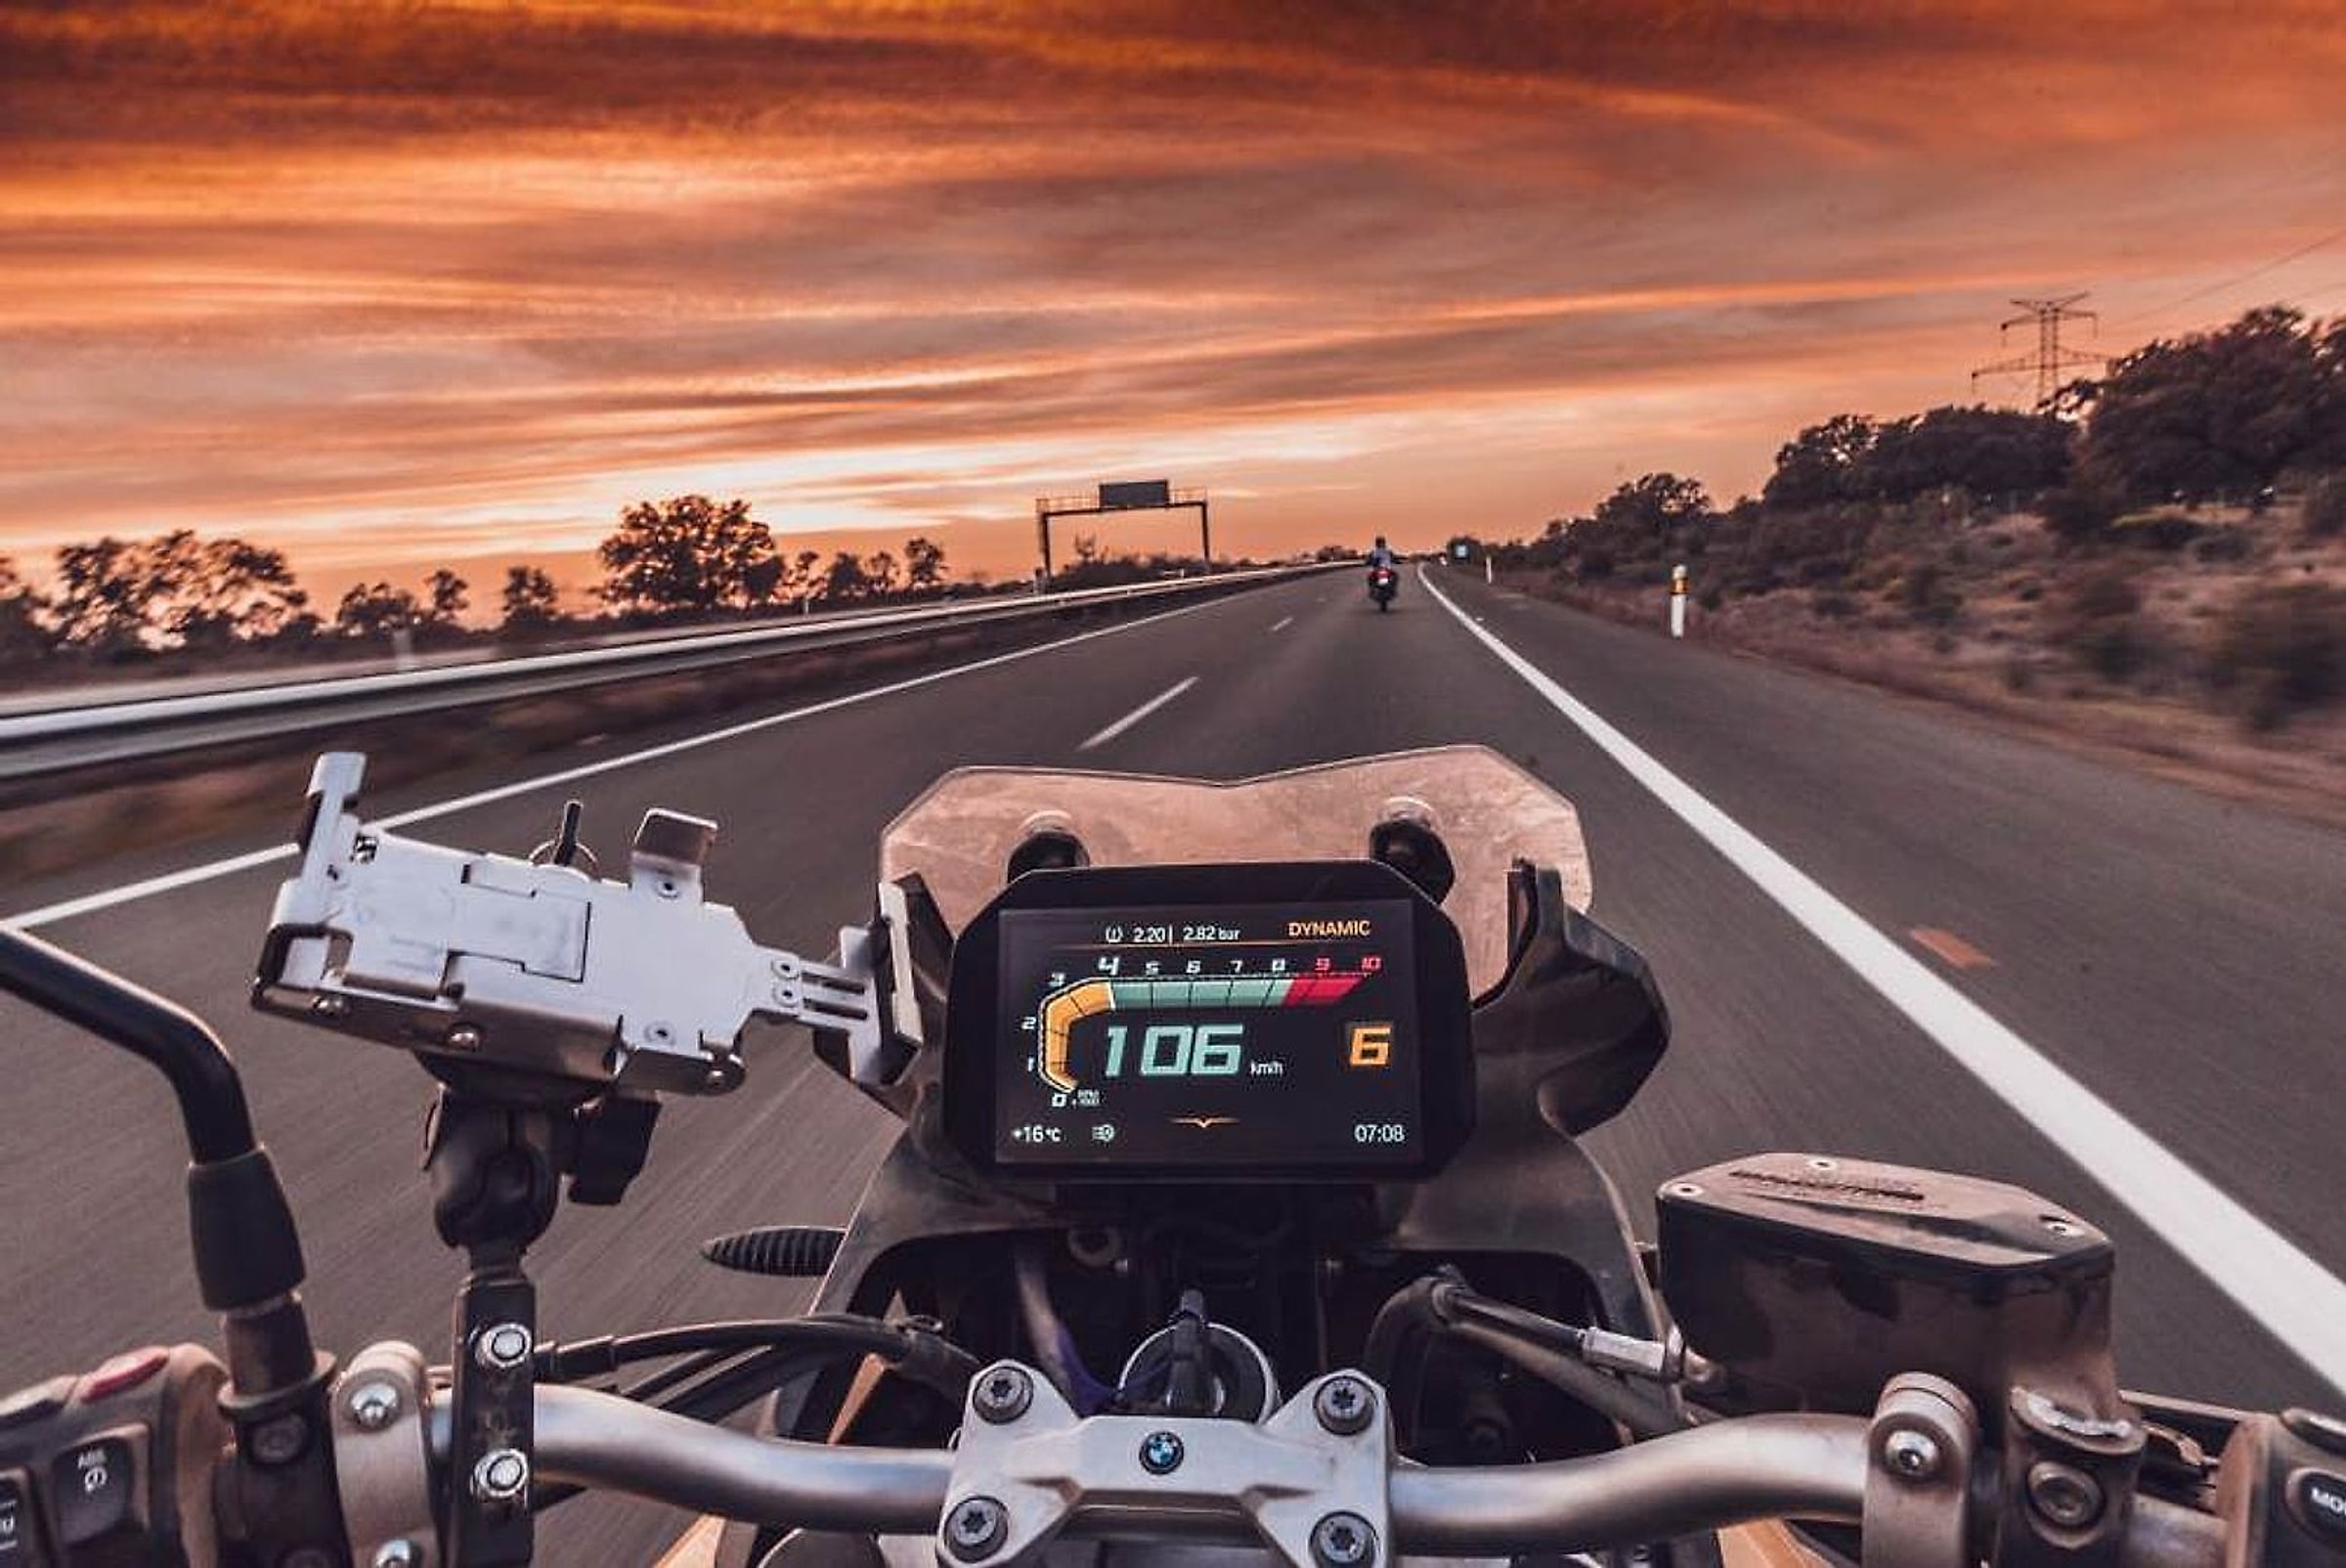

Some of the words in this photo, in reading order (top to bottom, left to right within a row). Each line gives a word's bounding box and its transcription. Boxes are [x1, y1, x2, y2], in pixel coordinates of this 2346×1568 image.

[1287, 920, 1370, 936] DYNAMIC
[1098, 957, 1119, 976] 4
[1145, 961, 1160, 976] 5
[1186, 960, 1201, 974] 6
[1230, 960, 1243, 973] 7
[1272, 959, 1285, 972] 8
[1315, 958, 1329, 971] 9
[1362, 957, 1381, 971] 10
[1021, 1017, 1036, 1030] 2
[1106, 1024, 1243, 1076] 106
[1350, 1027, 1390, 1066] 6
[1027, 1057, 1034, 1072] 1
[1051, 1093, 1067, 1107] 0
[1354, 1124, 1406, 1143] 07:08
